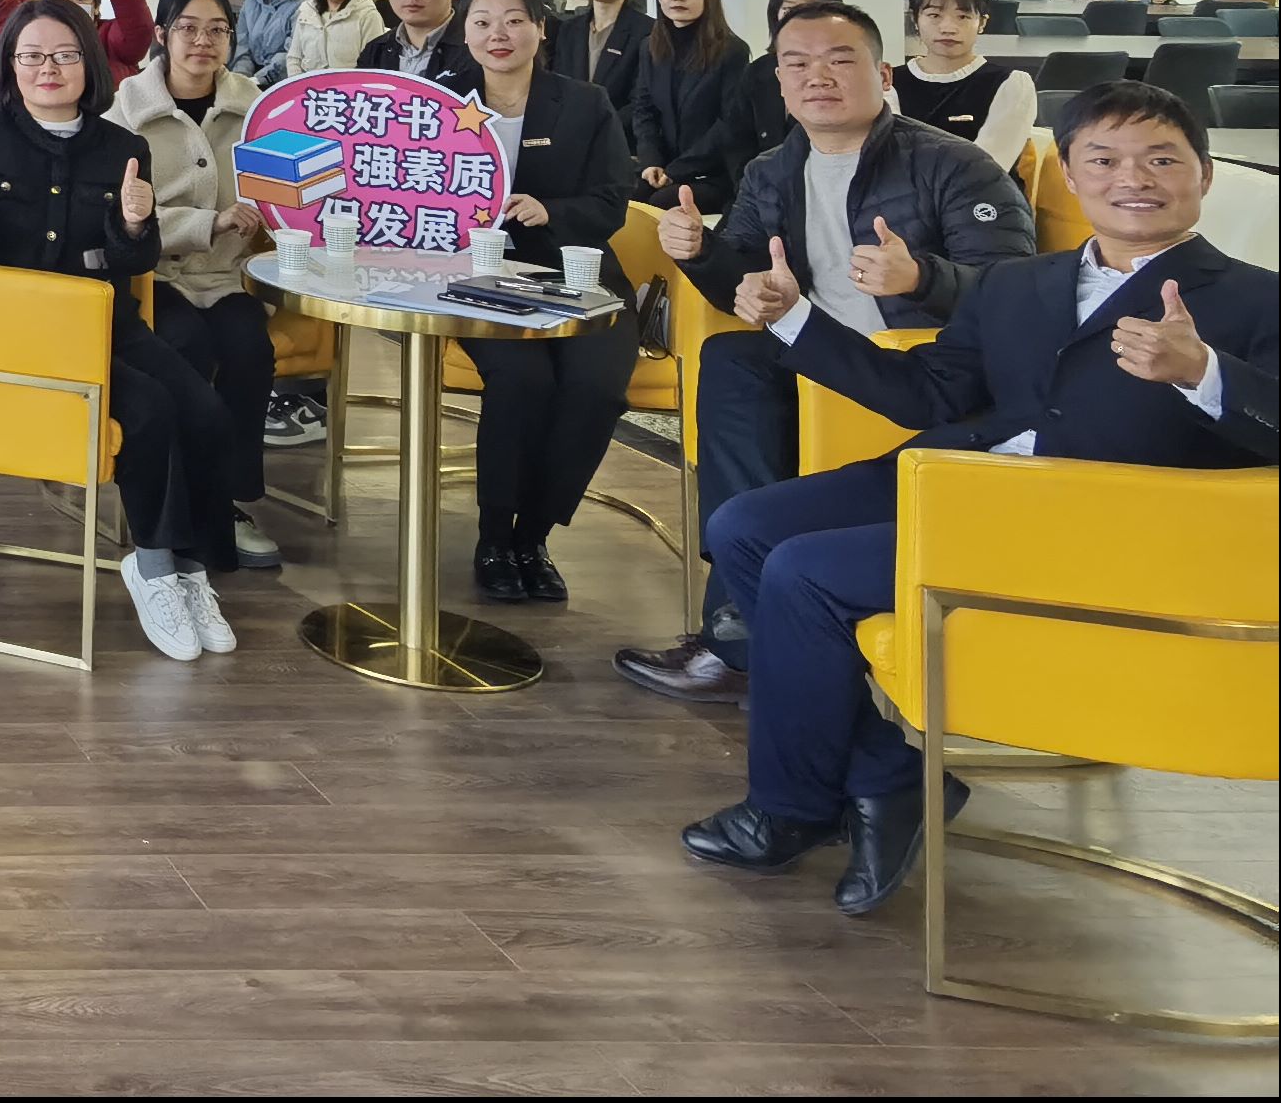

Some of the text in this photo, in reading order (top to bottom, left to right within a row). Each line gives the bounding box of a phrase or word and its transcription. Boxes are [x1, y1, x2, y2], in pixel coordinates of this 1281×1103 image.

[303, 89, 441, 139] 读好书
[353, 144, 496, 198] 强素质
